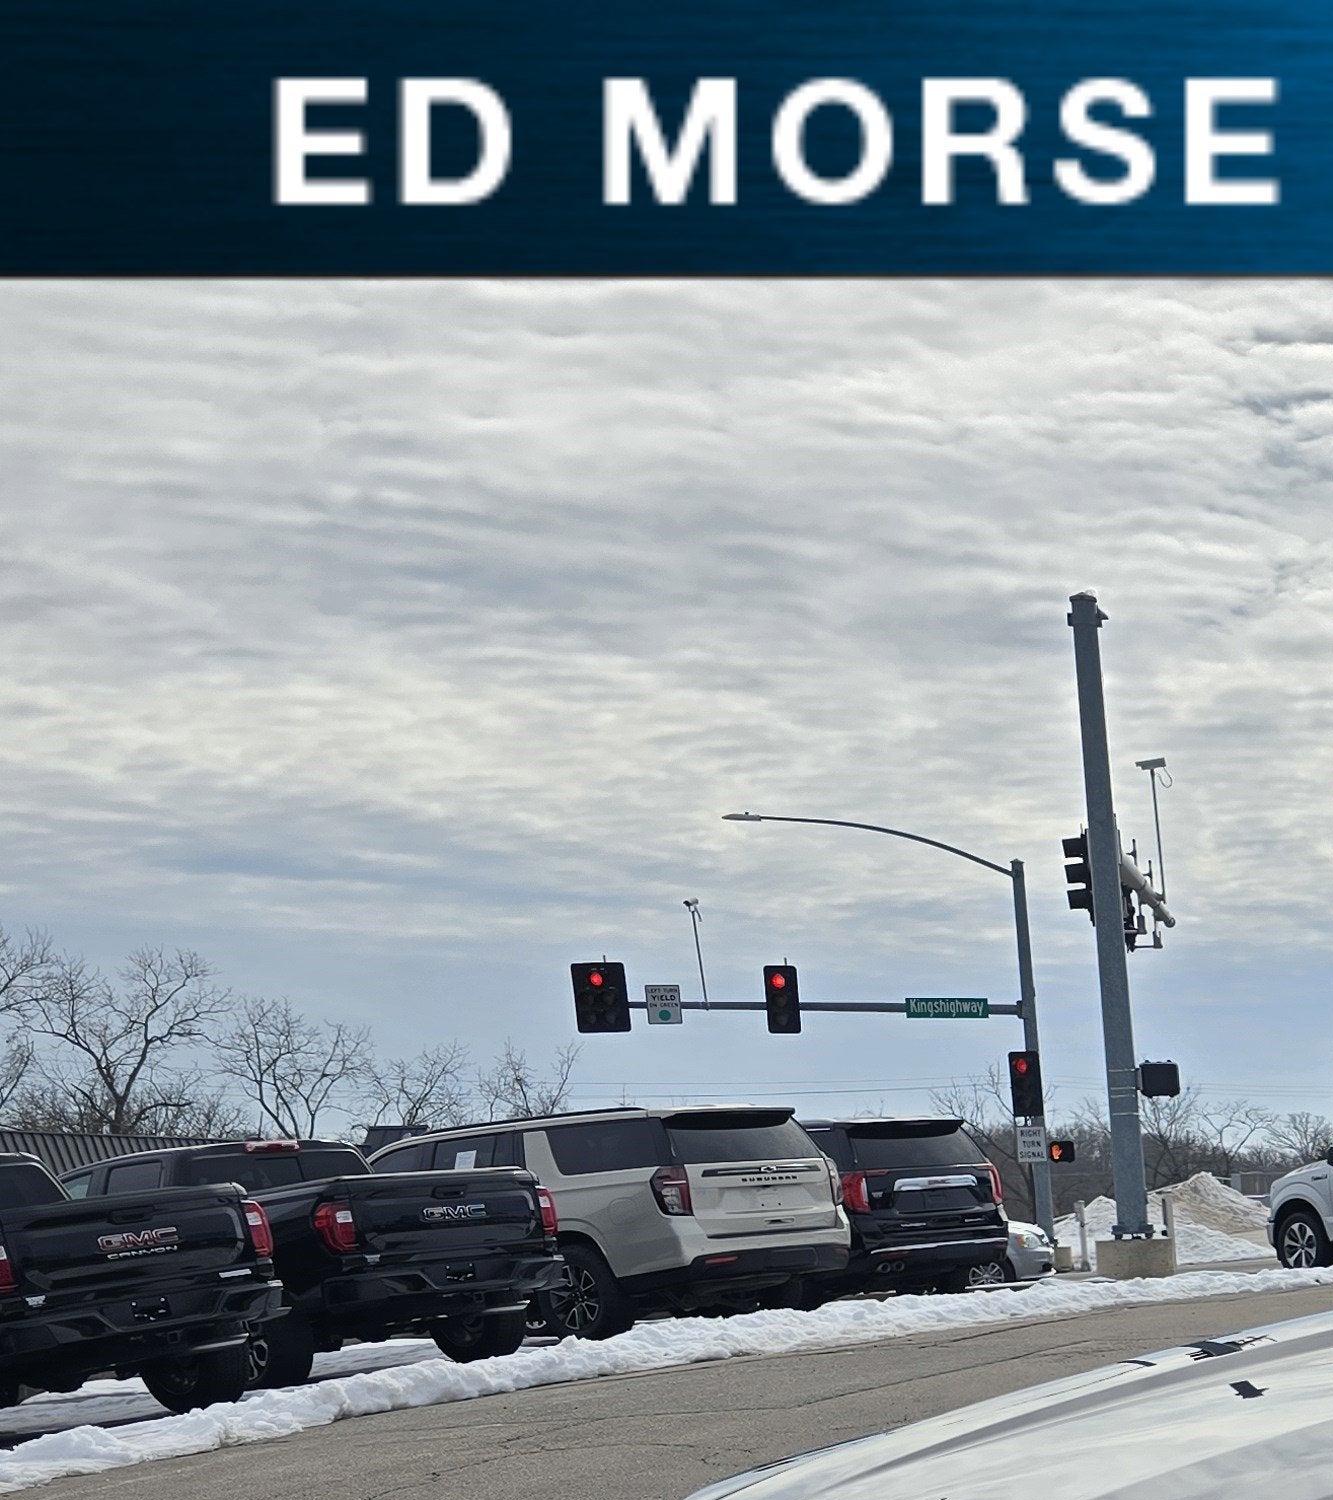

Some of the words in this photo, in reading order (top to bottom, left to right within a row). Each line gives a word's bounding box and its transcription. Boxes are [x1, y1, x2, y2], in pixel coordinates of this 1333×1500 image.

[909, 999, 984, 1017] Kingshighway
[1023, 1140, 1042, 1148] TURN
[1019, 1151, 1045, 1159] SIGNAL
[422, 1203, 488, 1222] GMC
[97, 1226, 180, 1252] GMC
[107, 1245, 178, 1260] CANYON
